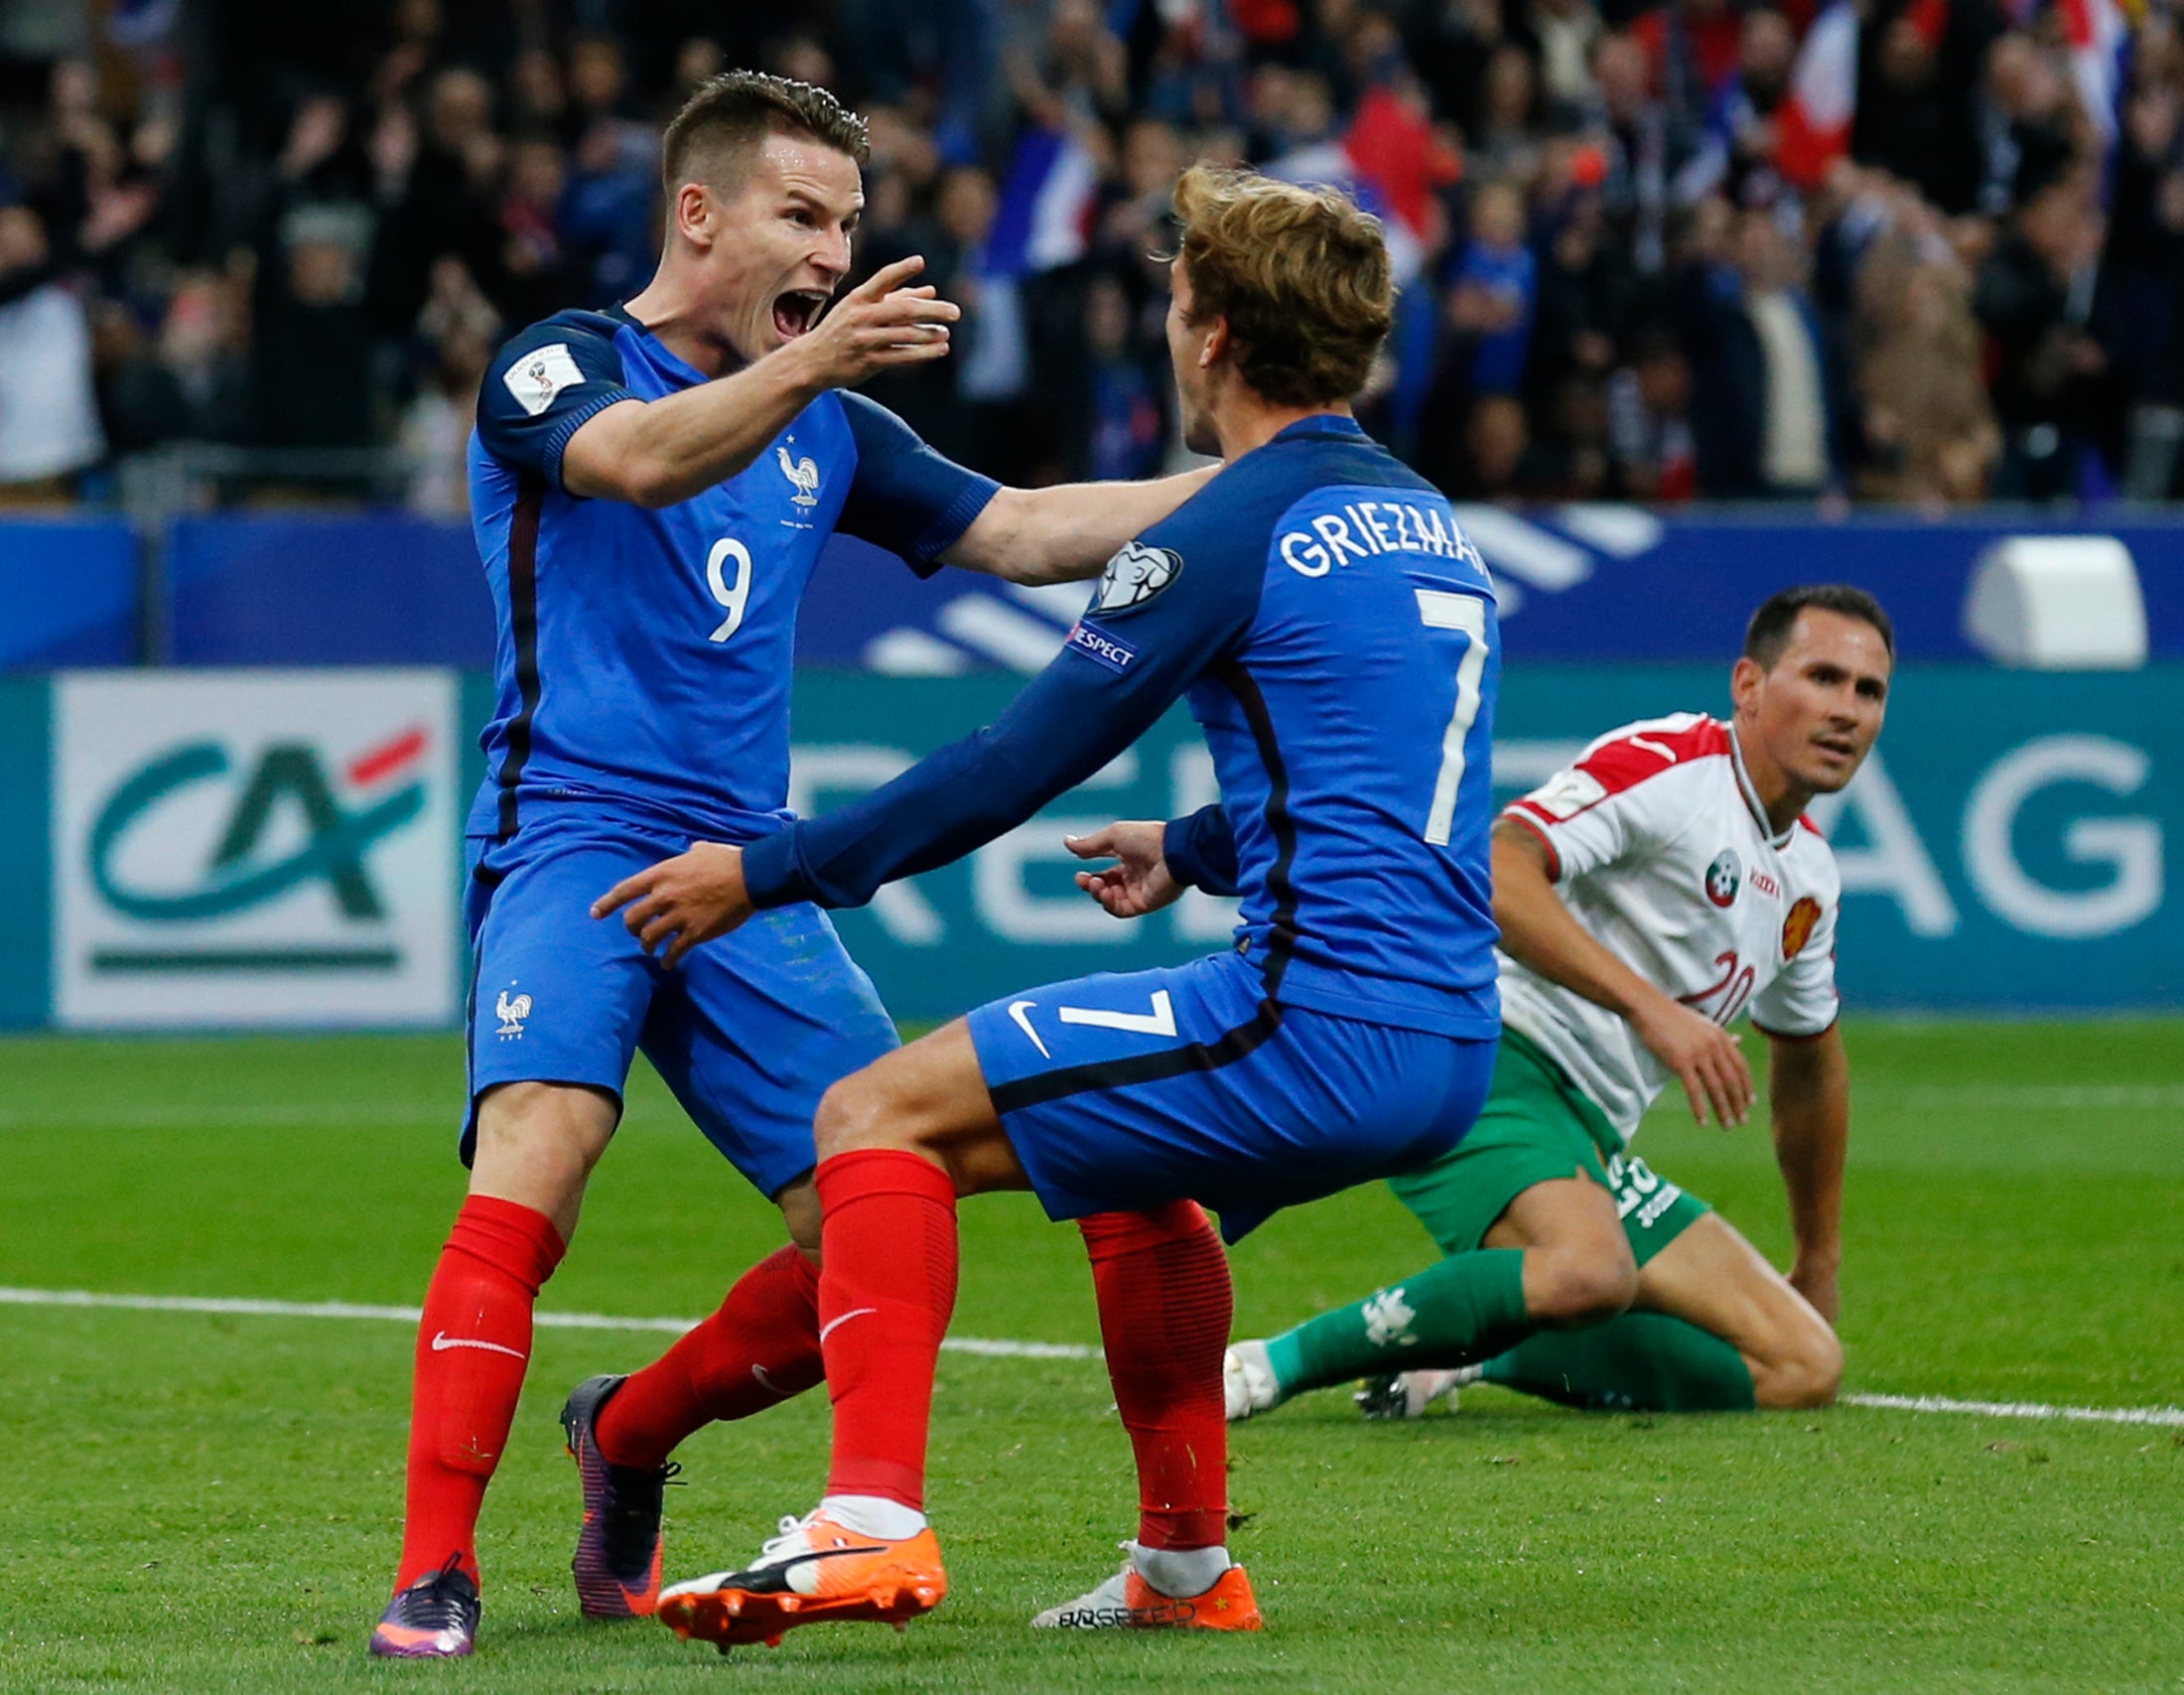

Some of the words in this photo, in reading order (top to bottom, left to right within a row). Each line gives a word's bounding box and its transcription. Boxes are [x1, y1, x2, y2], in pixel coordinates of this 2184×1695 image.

[706, 537, 751, 643] 9
[1070, 625, 1135, 666] ESPECT
[1414, 589, 1488, 847] 7
[1058, 989, 1178, 1037] 7
[1675, 949, 1755, 1027] 20
